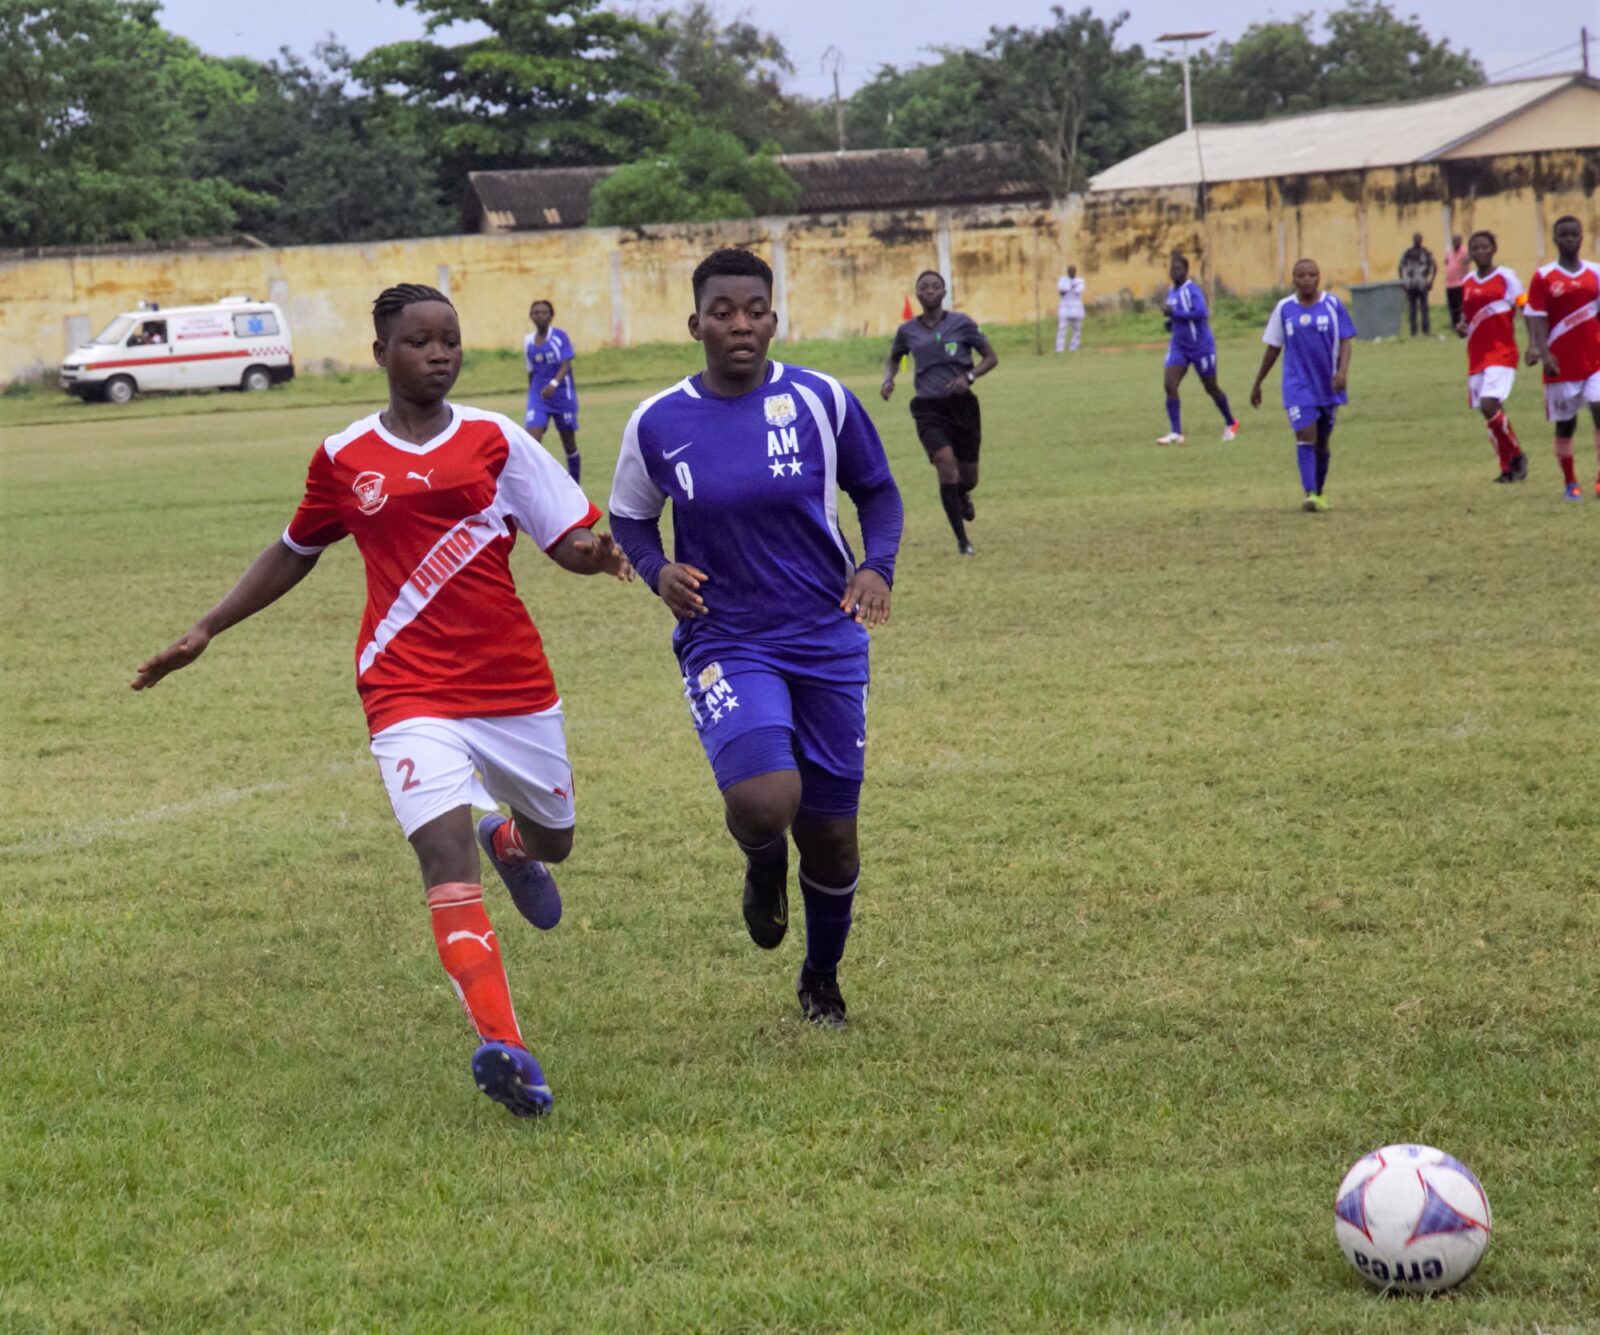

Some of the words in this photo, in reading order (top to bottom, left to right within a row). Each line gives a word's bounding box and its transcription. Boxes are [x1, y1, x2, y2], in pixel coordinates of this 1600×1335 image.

[767, 427, 799, 457] AM
[674, 461, 694, 500] 9
[409, 527, 477, 599] PUMA
[705, 678, 733, 711] AM
[396, 757, 421, 792] 2
